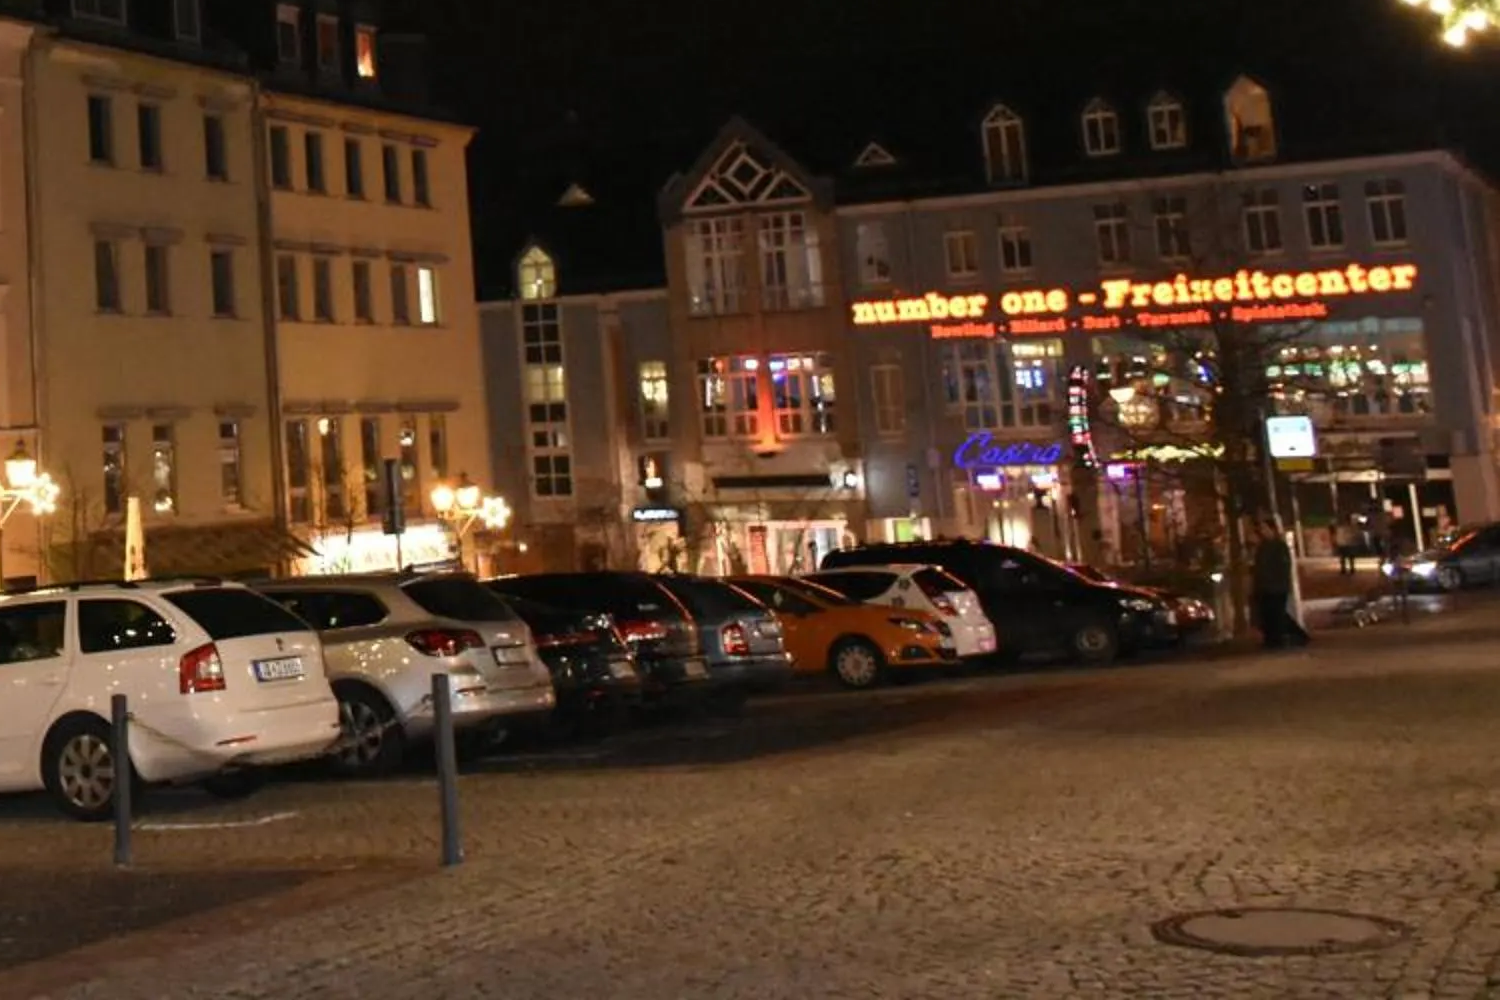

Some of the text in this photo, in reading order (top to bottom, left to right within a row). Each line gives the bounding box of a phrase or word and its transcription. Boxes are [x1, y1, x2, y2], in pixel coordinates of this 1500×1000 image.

[852, 291, 988, 324] number
[1001, 288, 1067, 314] one
[1102, 263, 1417, 309] Freizeitcenter
